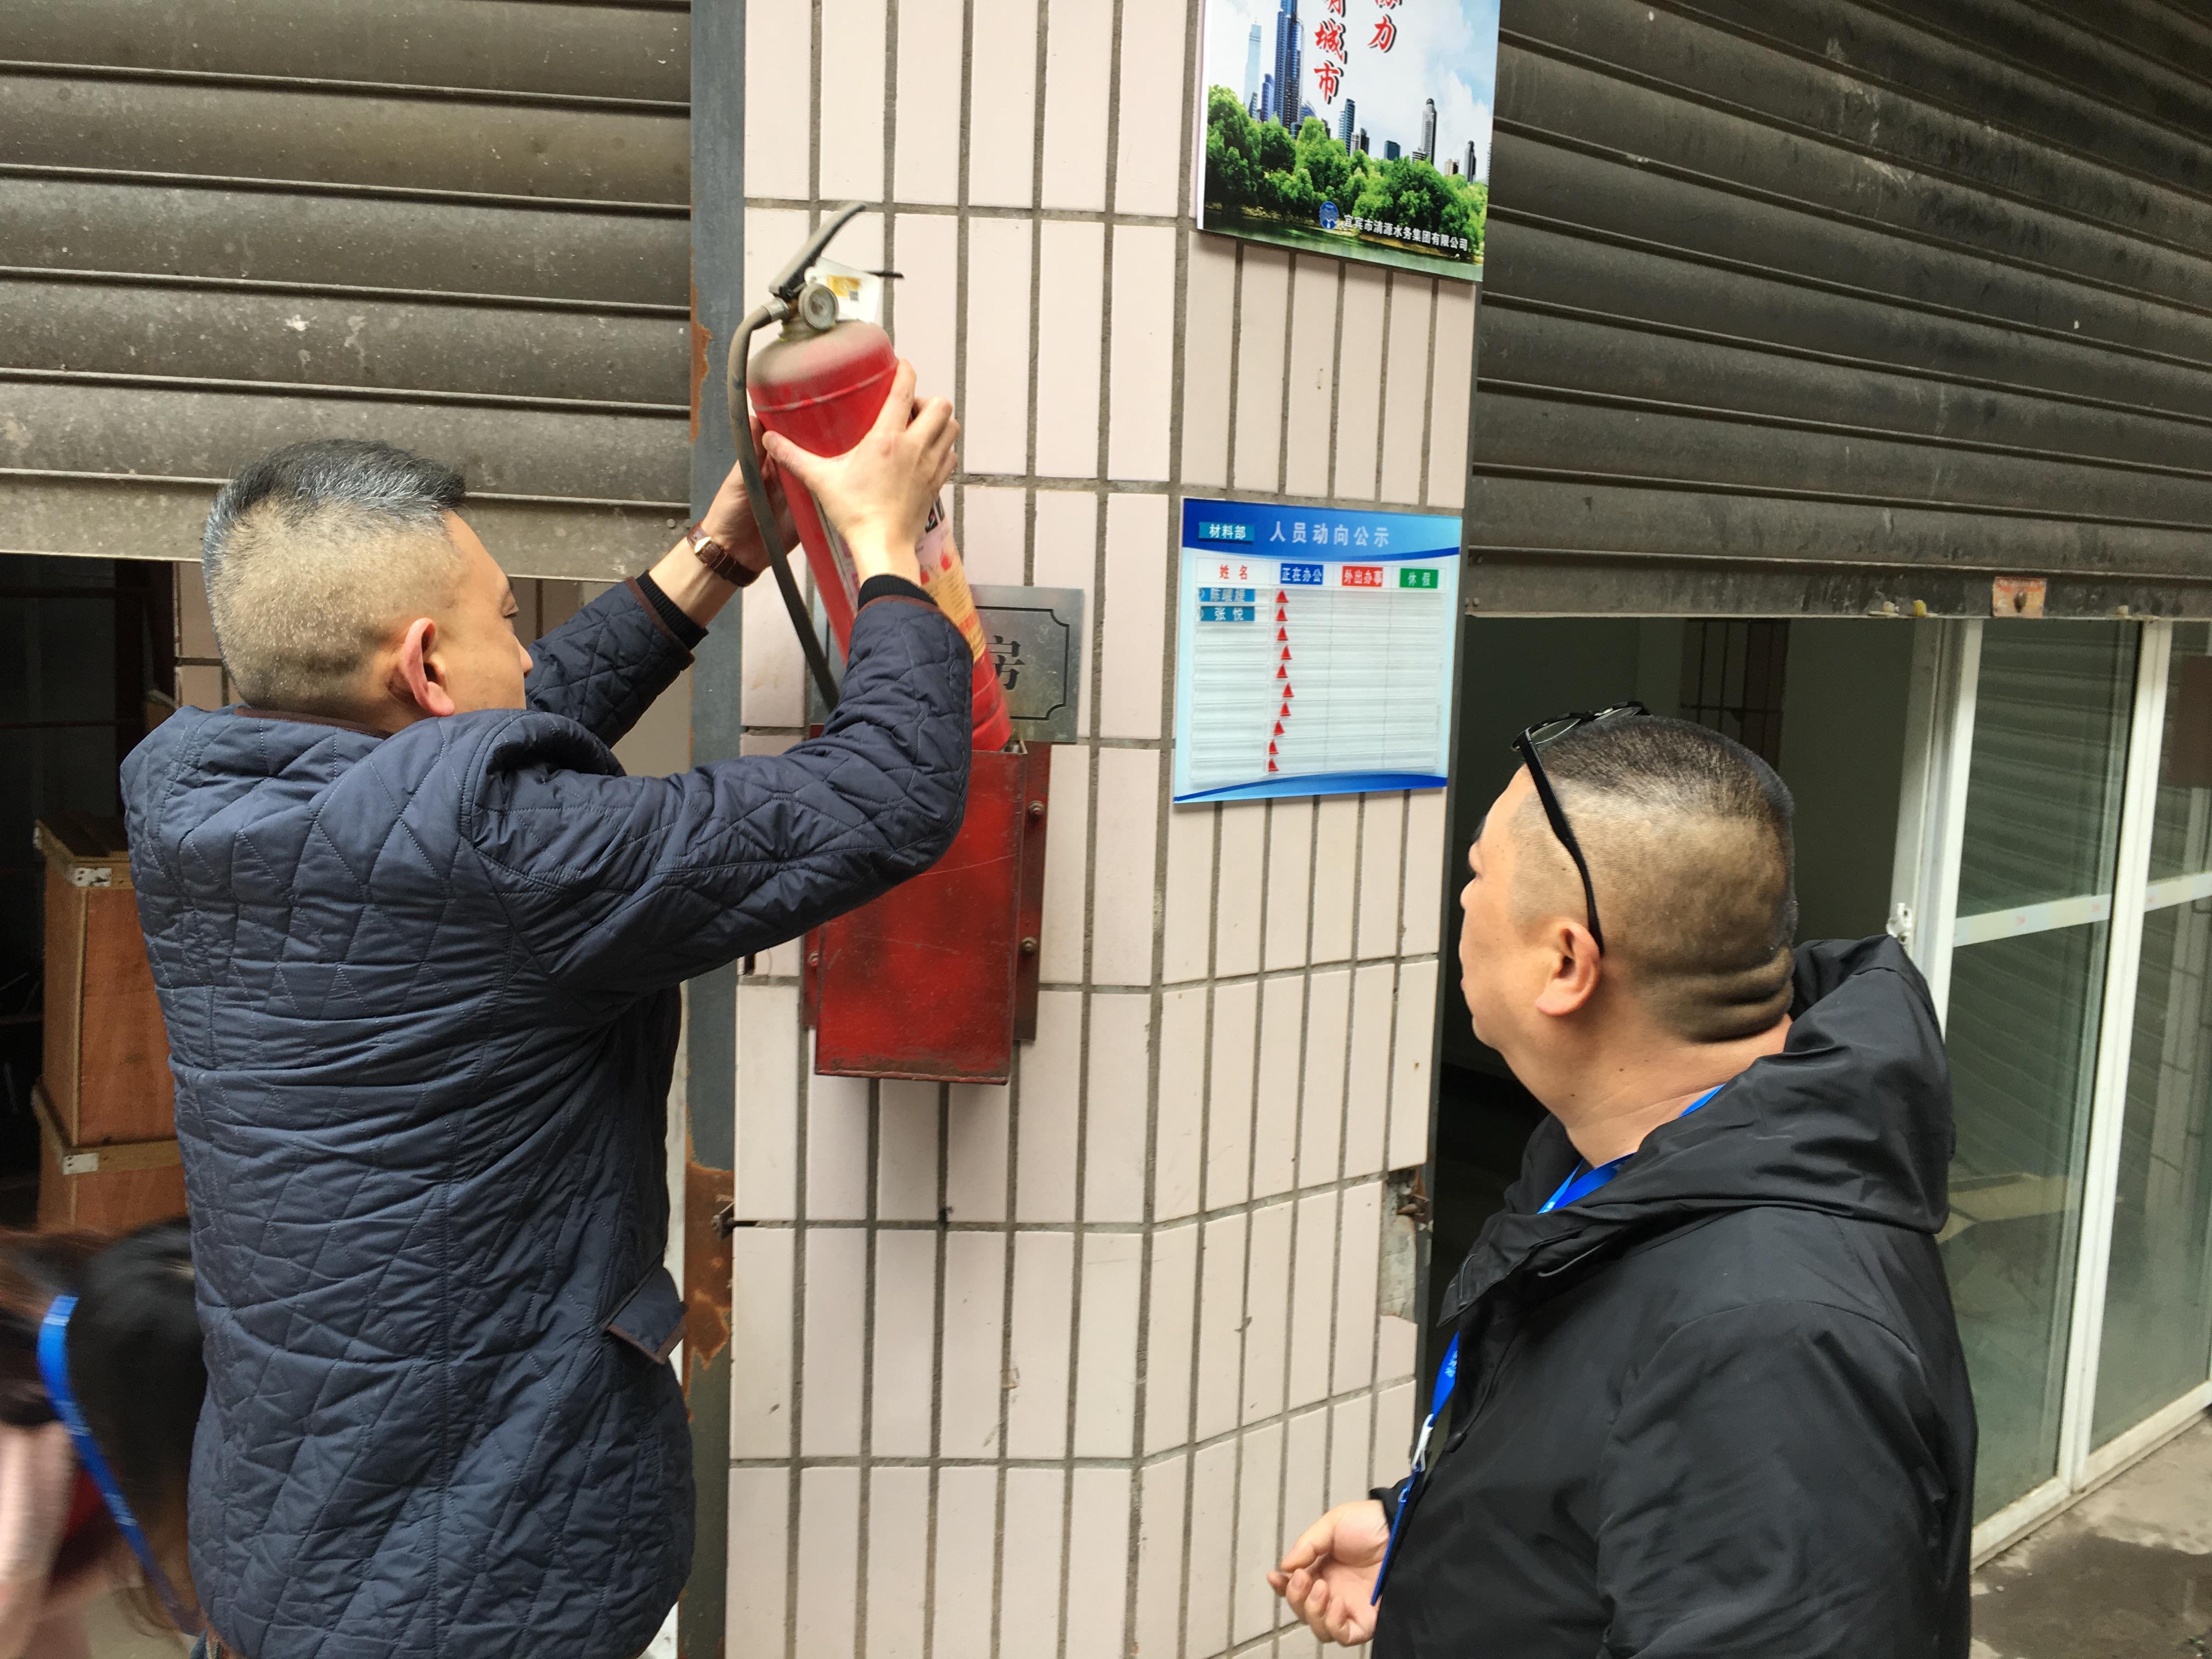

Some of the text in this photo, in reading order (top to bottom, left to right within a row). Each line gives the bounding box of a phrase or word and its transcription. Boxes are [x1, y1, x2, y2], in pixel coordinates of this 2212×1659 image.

[1344, 214, 1468, 251] 宜宾市清源水务集团有限公司
[1209, 523, 1246, 540] 材料部
[1269, 521, 1390, 548] 人员动向公示
[1220, 565, 1248, 580] 姓名
[1281, 567, 1322, 583] 正在办公
[1344, 568, 1383, 585] 外出办事
